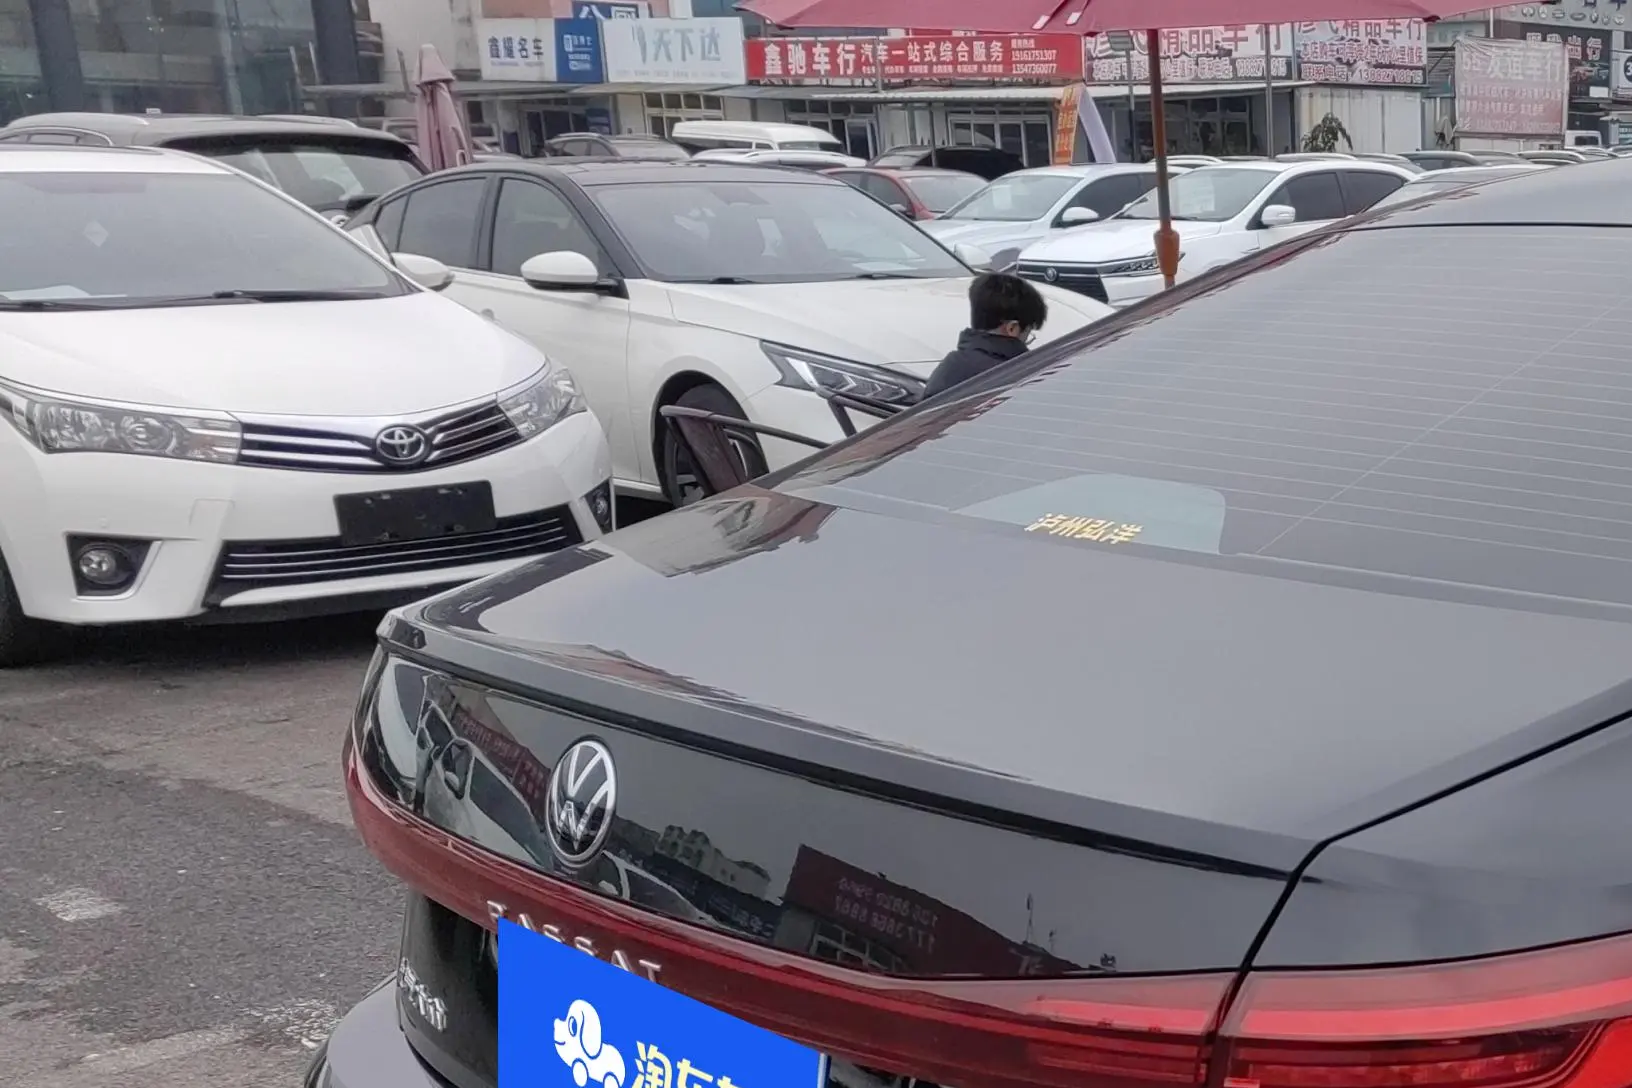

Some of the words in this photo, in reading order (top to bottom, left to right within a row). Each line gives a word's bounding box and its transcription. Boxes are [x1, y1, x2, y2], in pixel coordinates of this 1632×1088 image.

[764, 43, 856, 75] 鑫驰车行
[861, 40, 1003, 63] 汽车一站式综合服务
